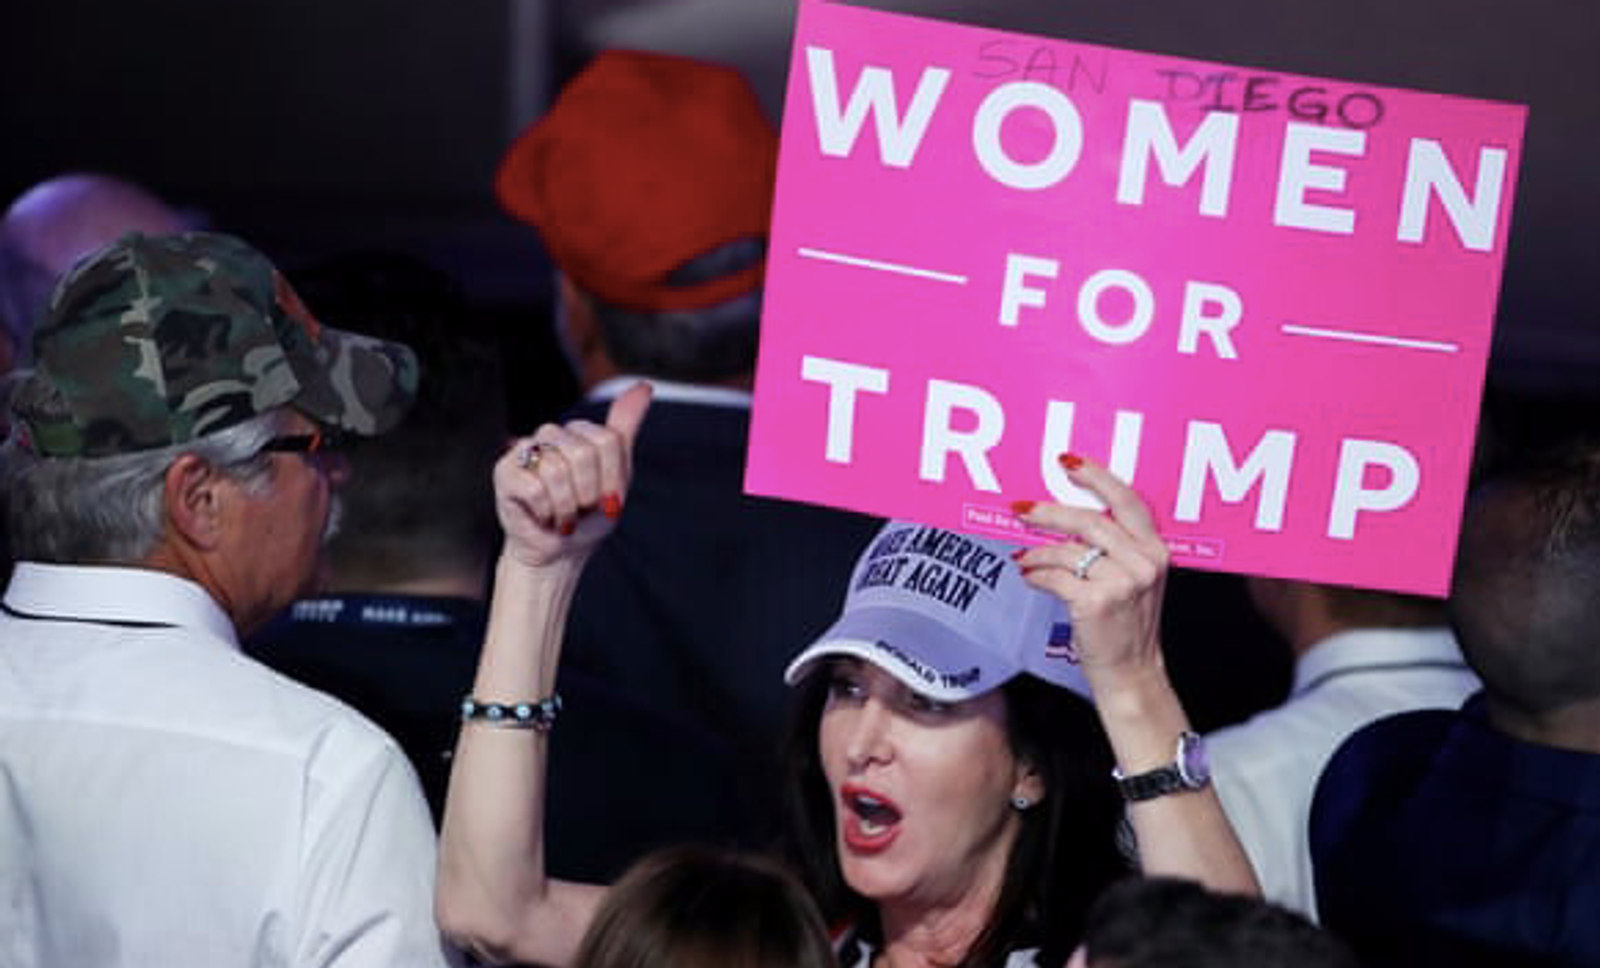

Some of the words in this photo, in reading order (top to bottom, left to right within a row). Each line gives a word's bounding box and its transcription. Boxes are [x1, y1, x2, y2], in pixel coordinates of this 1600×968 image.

[973, 39, 1108, 95] SAN
[1155, 68, 1385, 130] DIEGO
[806, 46, 1507, 252] WOMEN
[1000, 253, 1244, 359] FOR
[801, 355, 1421, 540] TRUMP
[902, 560, 979, 613] AGAIN
[905, 526, 1006, 590] AMERICA
